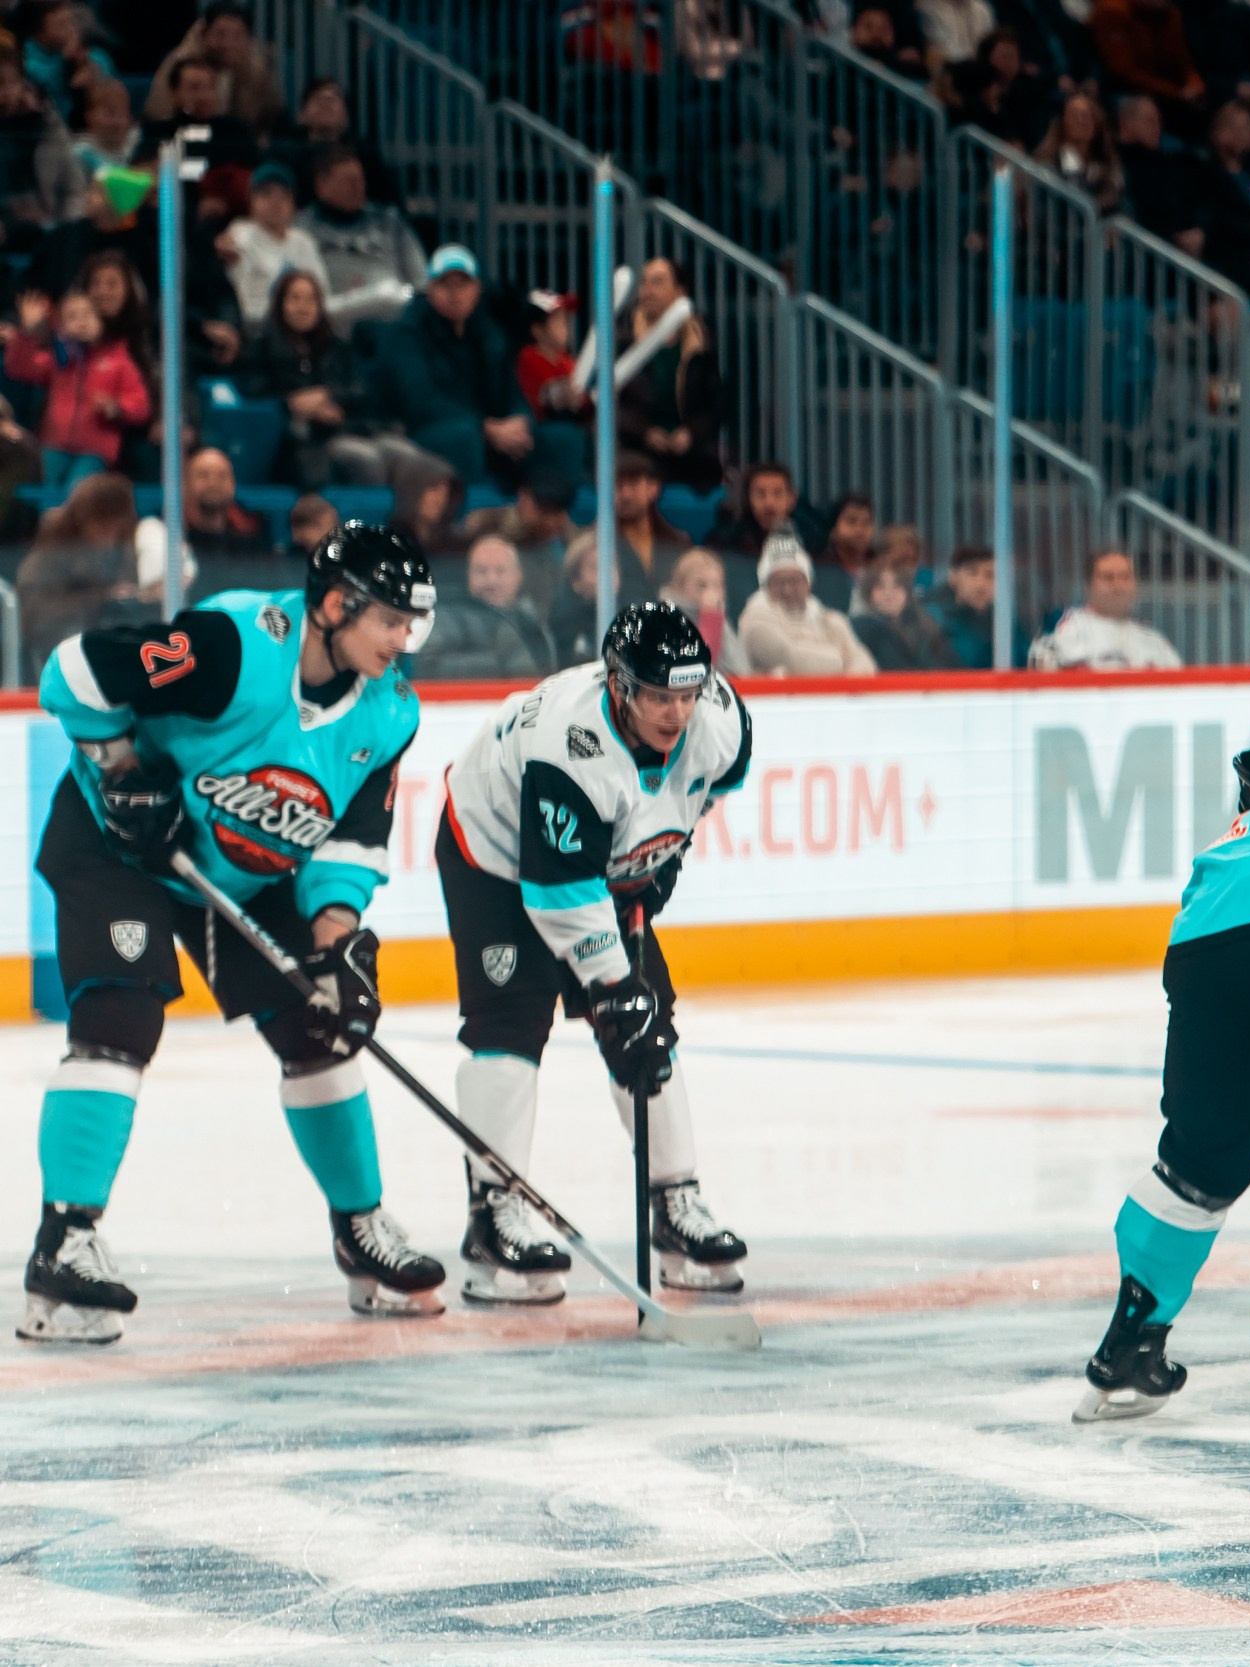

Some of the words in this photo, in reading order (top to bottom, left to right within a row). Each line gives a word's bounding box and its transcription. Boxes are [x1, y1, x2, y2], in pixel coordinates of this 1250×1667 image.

[140, 631, 195, 688] 21
[197, 774, 336, 848] All-Sta
[539, 798, 582, 853] 32
